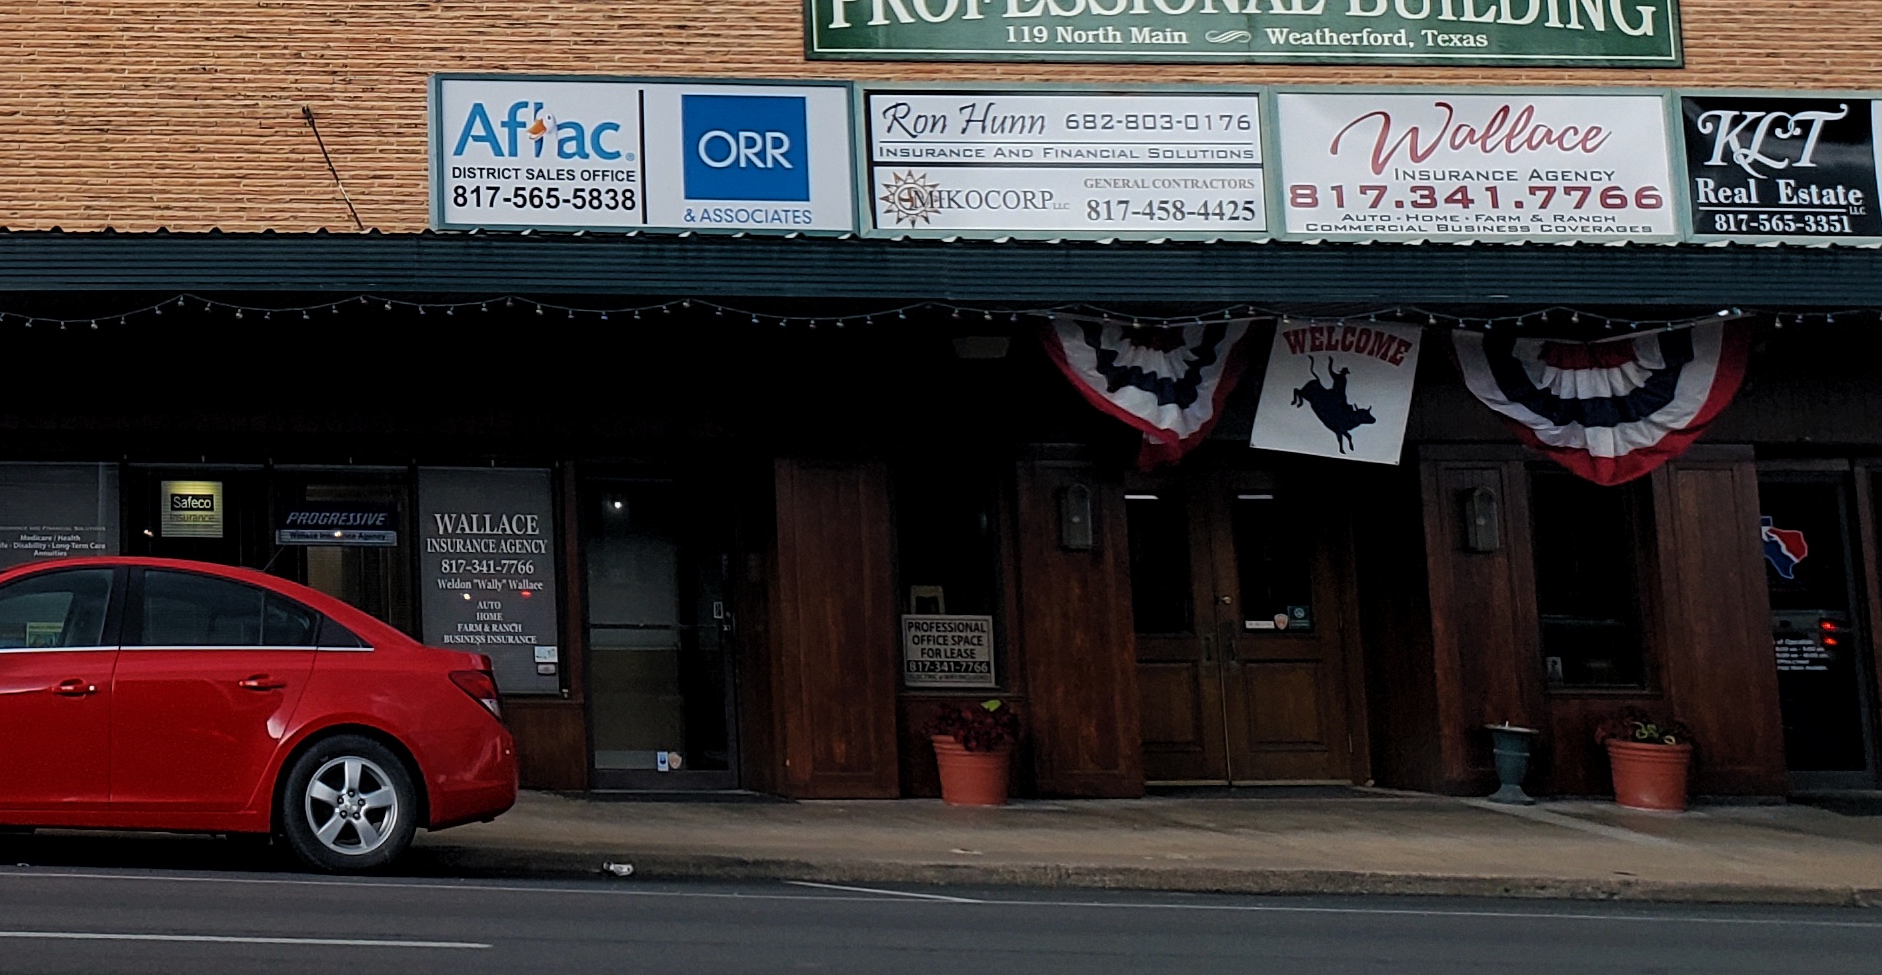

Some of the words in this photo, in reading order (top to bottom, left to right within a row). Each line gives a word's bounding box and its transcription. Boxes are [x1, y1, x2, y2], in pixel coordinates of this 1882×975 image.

[1005, 26, 1049, 44] 119
[1055, 25, 1123, 45] North
[1129, 26, 1190, 45] Main
[1264, 27, 1415, 49] Weatherford,
[1424, 29, 1489, 48] Texas
[881, 101, 948, 139] Ron
[959, 102, 1046, 136] Hunn
[1064, 112, 1252, 132] 682-803-0176
[1329, 101, 1614, 176] Wallace
[698, 129, 794, 170] ORR
[451, 166, 522, 181] DISTRICT
[525, 168, 576, 182] SALES
[579, 169, 636, 183] OFFICE
[1083, 177, 1150, 190] GENERAL
[1151, 178, 1256, 190] CONTRACTORS
[1695, 177, 1760, 205] Real
[1775, 178, 1864, 206] Estate
[452, 185, 637, 211] 817-565-5838
[913, 189, 1054, 211] MIKOCORP
[1289, 184, 1664, 210] 817.341.7766
[683, 208, 697, 223] &
[699, 208, 813, 225] ASSOCIATES
[1086, 198, 1256, 222] 817-458-4425
[1529, 213, 1544, 224] &
[1714, 213, 1853, 234] 817-565-3351
[1283, 325, 1412, 367] WELCOME
[172, 495, 213, 510] Safeco
[285, 511, 389, 526] PROGRESSIVE
[434, 513, 540, 535] WALLACE
[319, 531, 357, 541] Insunce
[426, 538, 497, 554] INSURANCE
[498, 539, 548, 554] AGENCY
[440, 559, 535, 574] 817-341-7766
[437, 578, 472, 590] Weldon
[473, 578, 507, 592] "Wally"
[508, 579, 544, 591] Wallace
[476, 601, 502, 610] AUTO
[476, 612, 504, 621] HOME
[457, 623, 483, 633] FARM
[483, 624, 490, 633] &
[491, 623, 523, 633] RANCH
[908, 621, 986, 633] PROFESSIONAL
[443, 635, 486, 644] BUSINESS
[487, 635, 537, 644] INSURANCE
[912, 634, 949, 646] OFFICE
[951, 635, 983, 646] SPACE
[920, 647, 942, 659] FOR
[944, 648, 977, 660] LEASE
[909, 661, 989, 674] 817-341-7766
